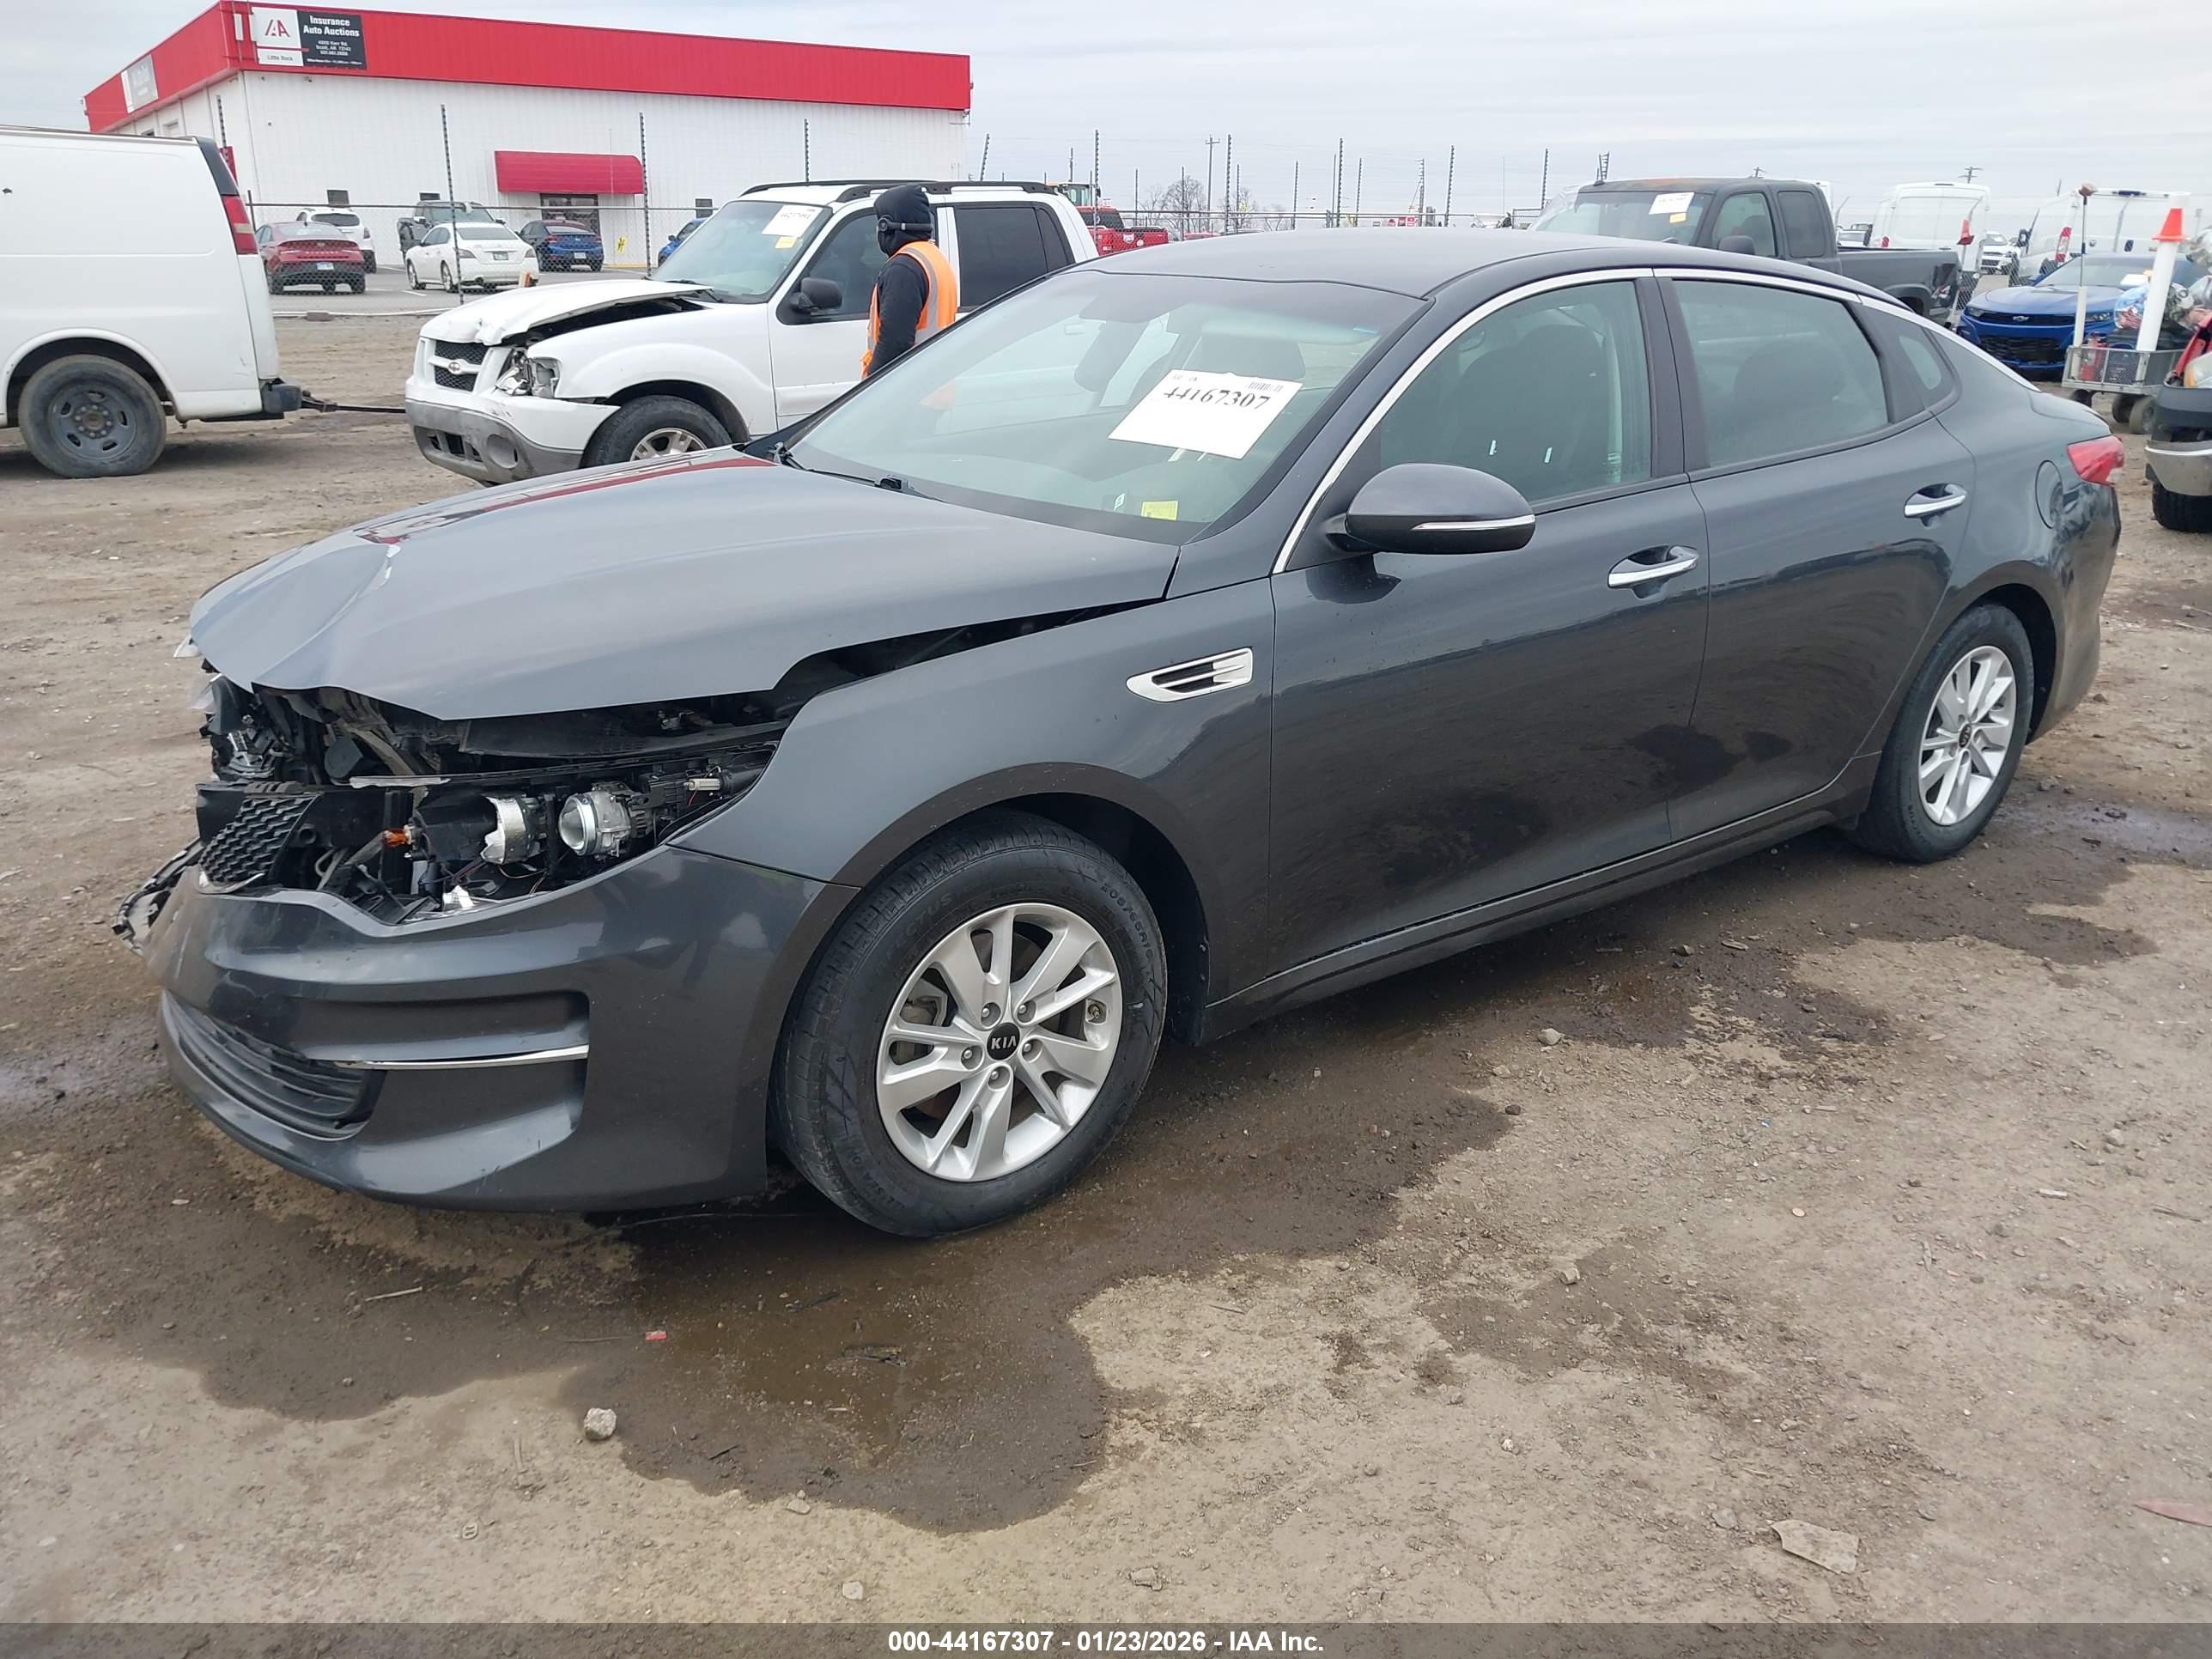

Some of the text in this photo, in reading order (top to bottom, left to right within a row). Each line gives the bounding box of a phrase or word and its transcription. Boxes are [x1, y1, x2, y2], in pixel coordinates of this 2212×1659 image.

[309, 15, 350, 27] Insurance
[303, 25, 360, 37] Auto Auctions
[1164, 386, 1271, 410] 44167307
[991, 1036, 1017, 1050] KIA
